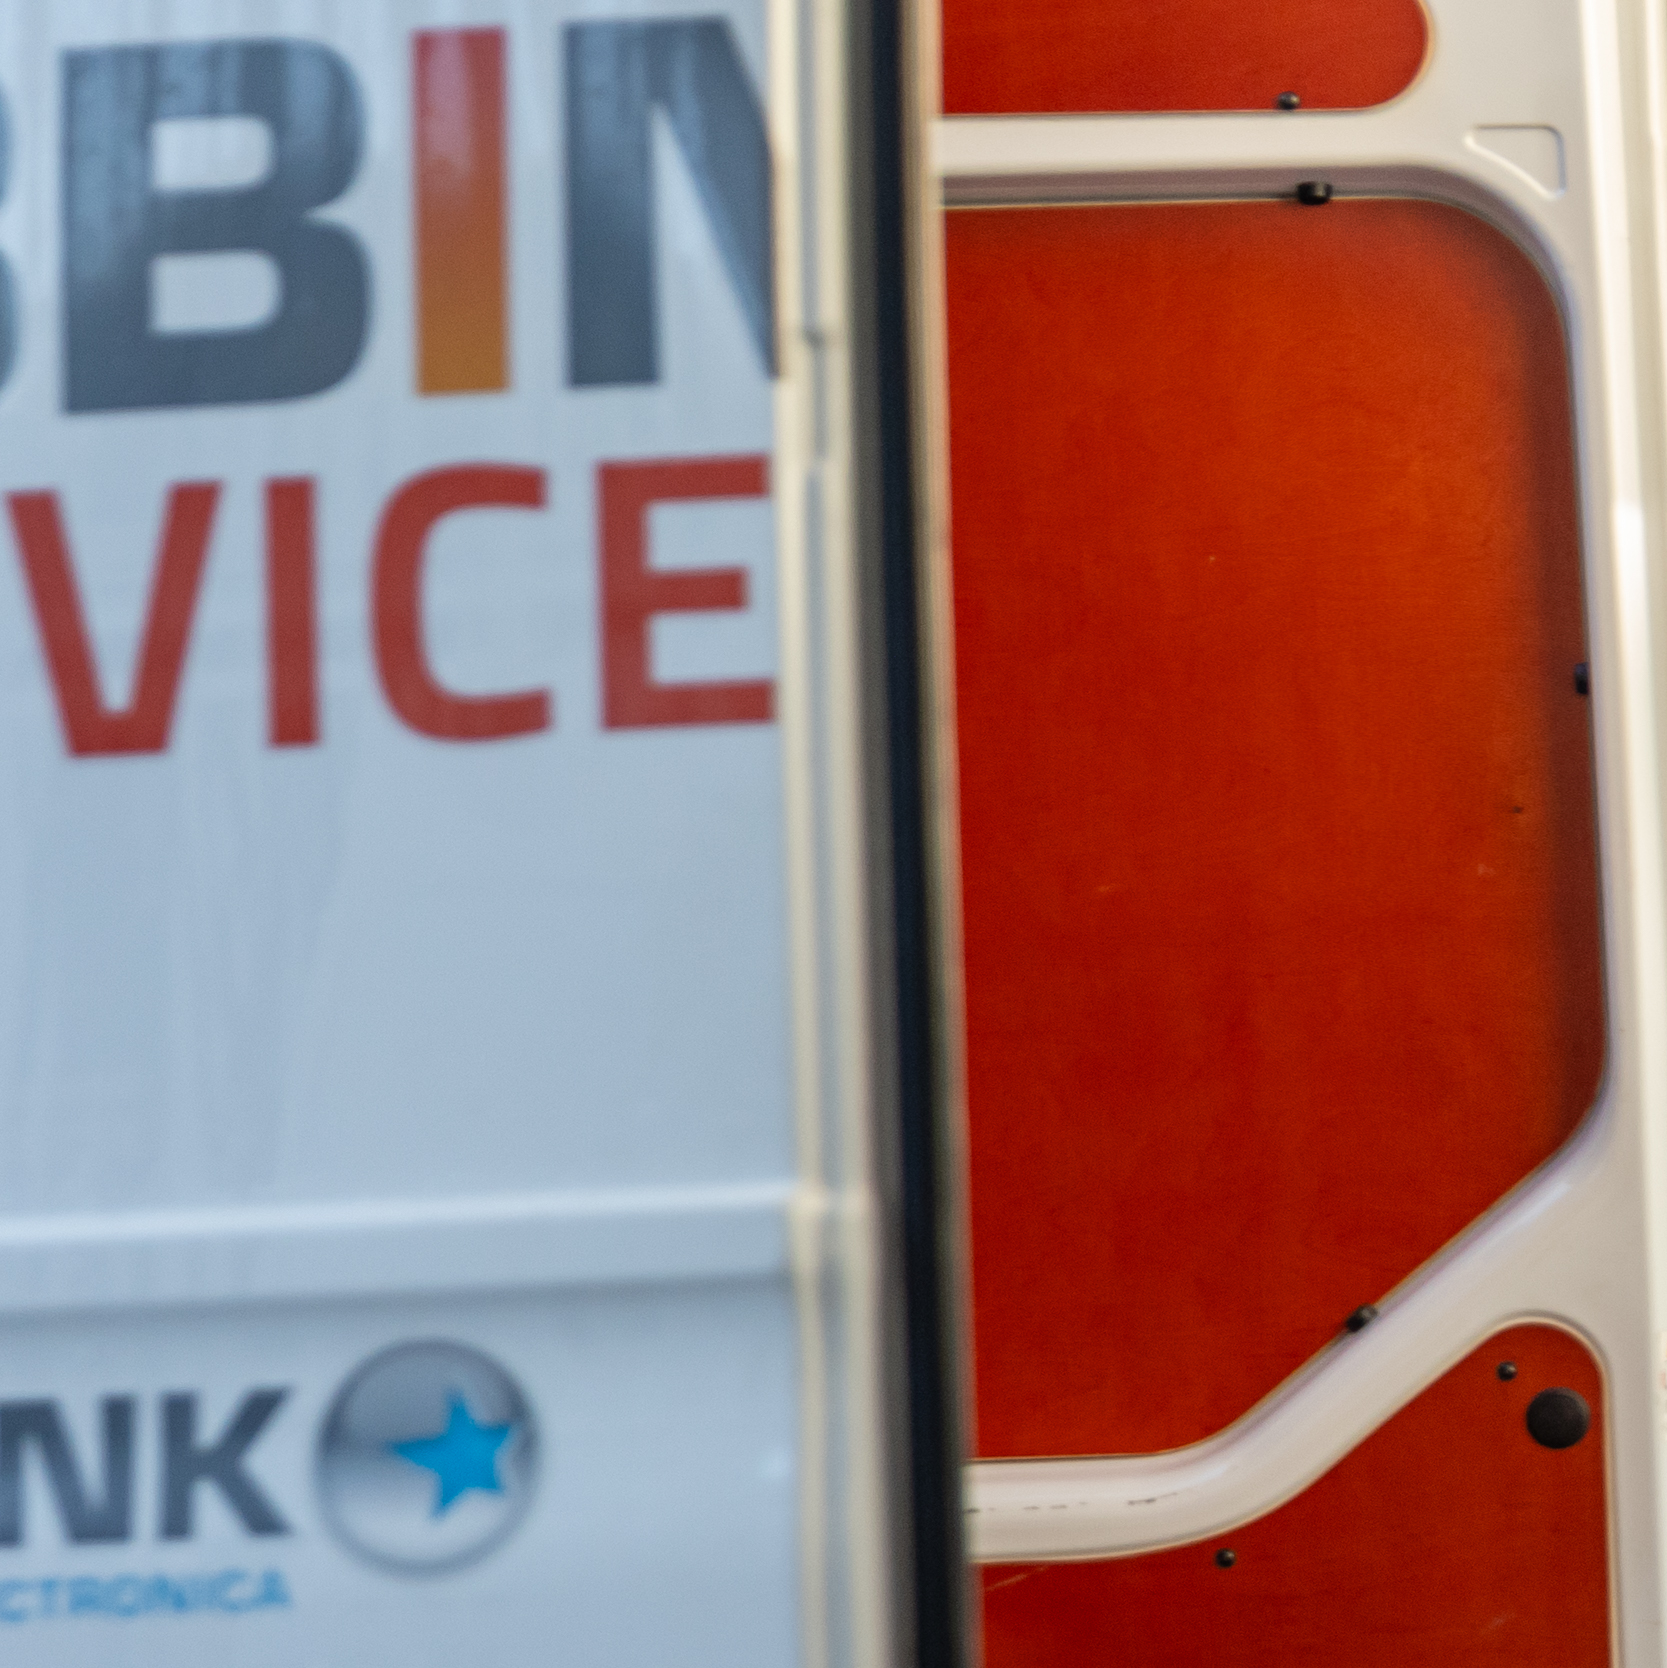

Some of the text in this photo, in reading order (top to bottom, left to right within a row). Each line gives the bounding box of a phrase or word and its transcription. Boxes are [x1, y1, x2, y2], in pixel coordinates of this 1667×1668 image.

[0, 14, 782, 414] BIN
[5, 453, 778, 758] VICE
[0, 1384, 294, 1548] NK
